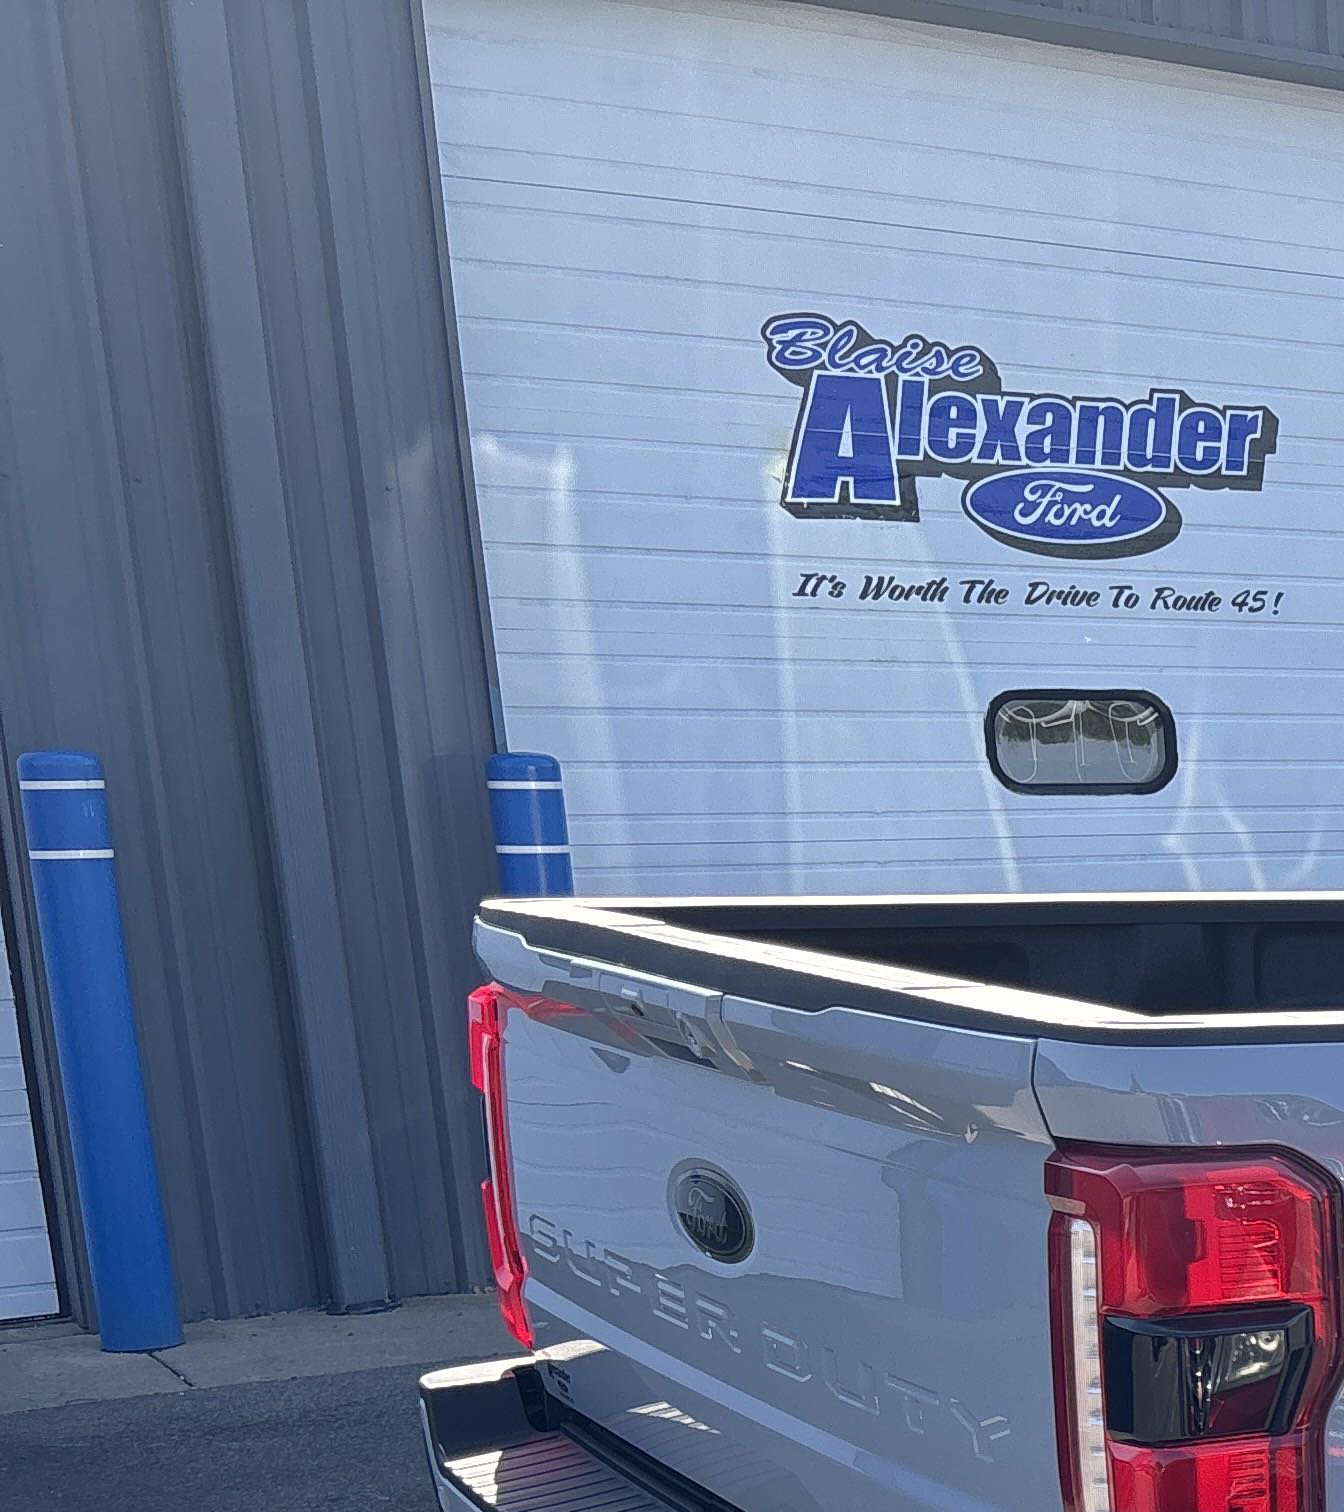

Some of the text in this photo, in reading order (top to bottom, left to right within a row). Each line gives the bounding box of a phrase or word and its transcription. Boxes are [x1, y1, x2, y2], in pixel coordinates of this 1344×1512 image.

[764, 315, 984, 383] Blaise
[785, 369, 1266, 506] Alexander
[1012, 478, 1122, 532] Ford
[791, 572, 847, 600] It's
[857, 574, 950, 604] Worth
[958, 579, 1011, 606] The
[1023, 580, 1101, 609] Drive
[1107, 584, 1141, 611] To
[1149, 586, 1223, 614] Route
[686, 1186, 729, 1246] Ford
[527, 1213, 1012, 1464] SUPER DUTY
